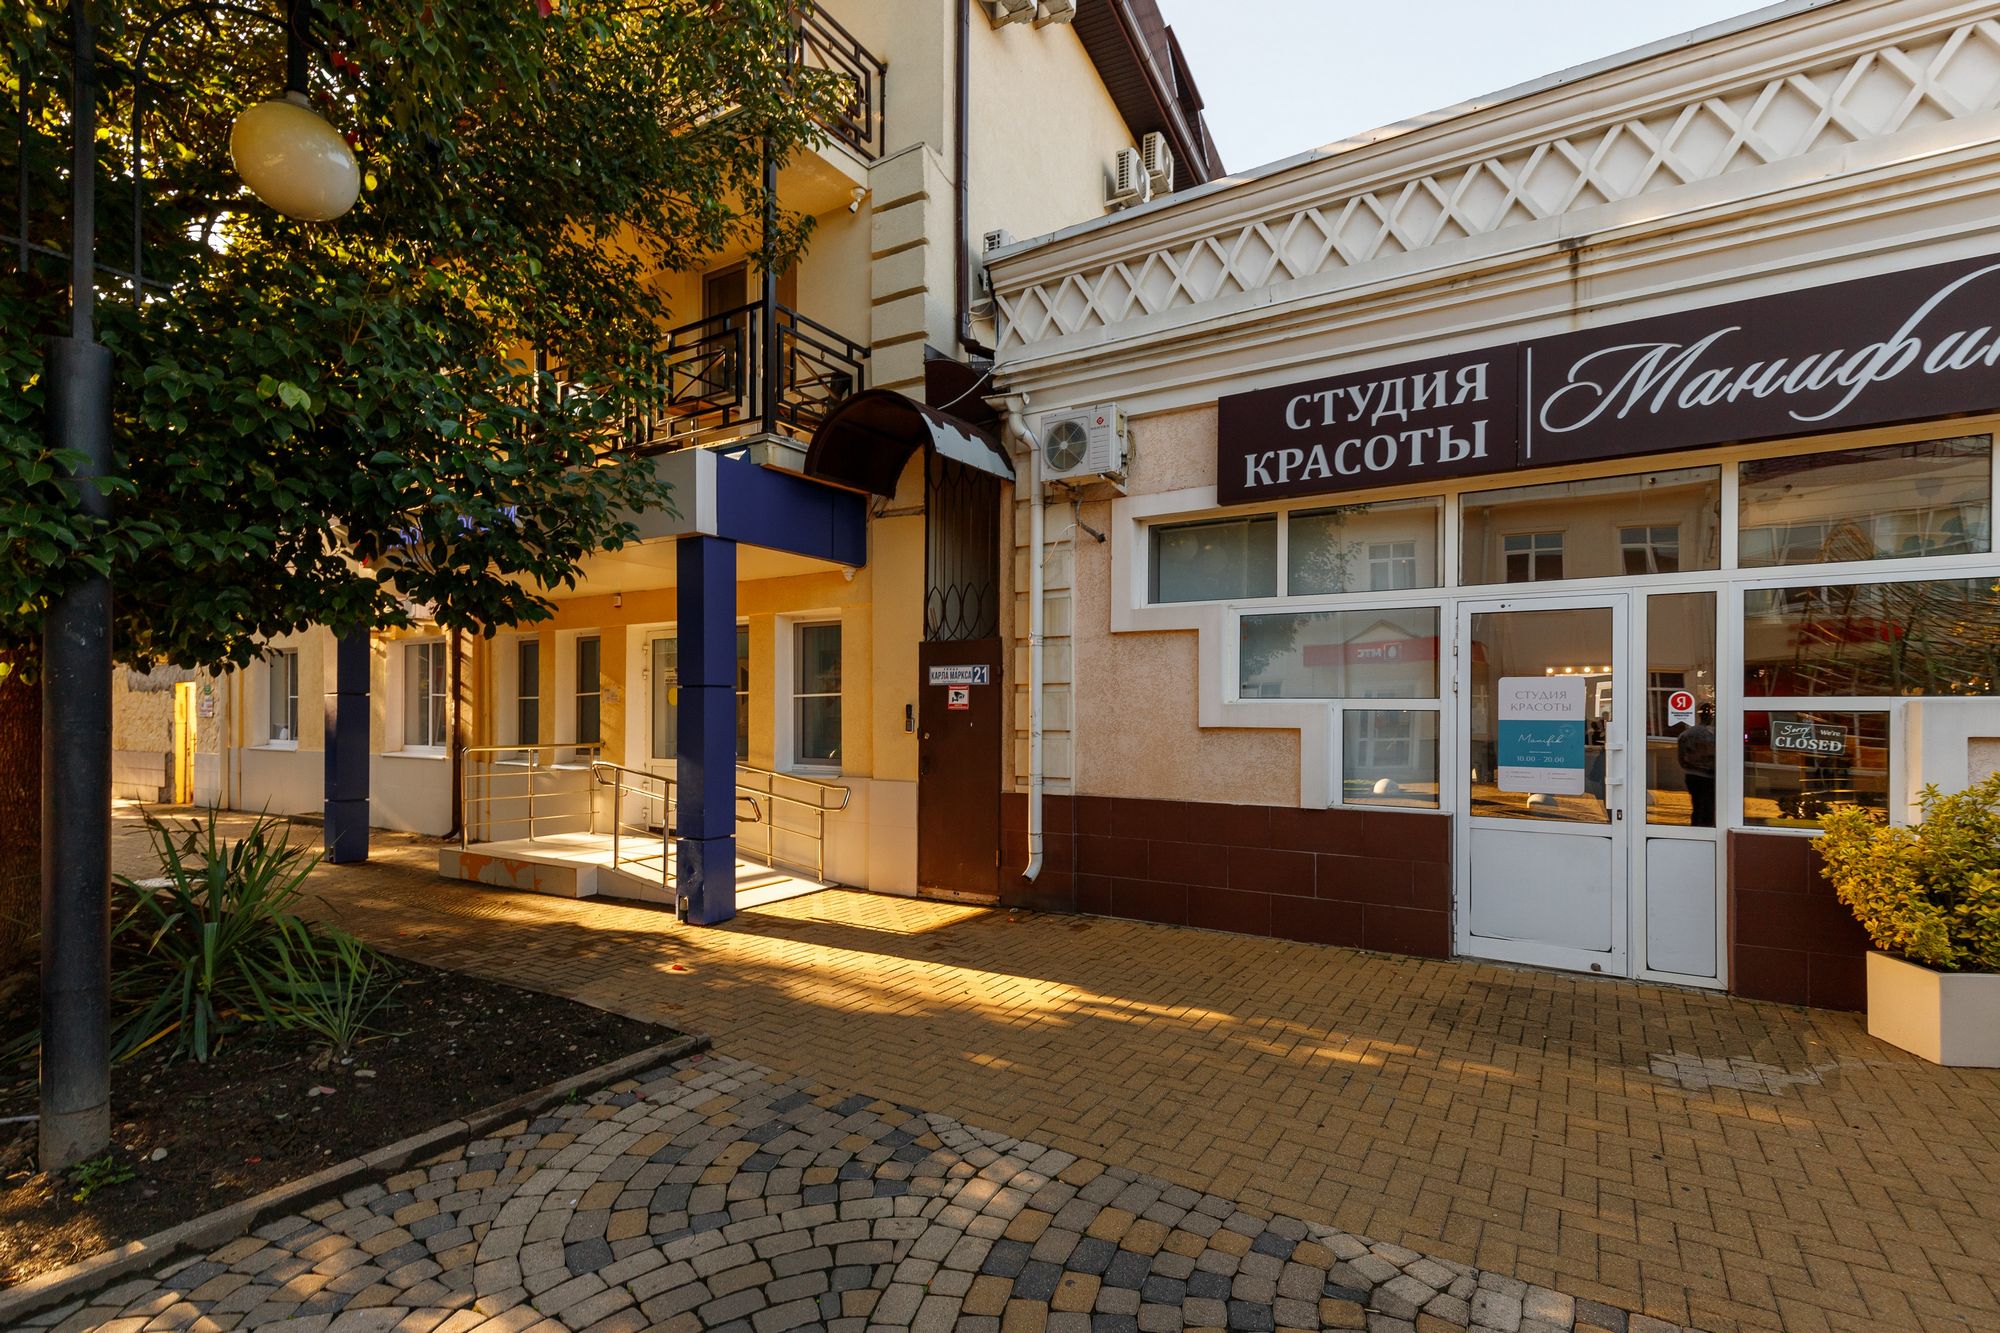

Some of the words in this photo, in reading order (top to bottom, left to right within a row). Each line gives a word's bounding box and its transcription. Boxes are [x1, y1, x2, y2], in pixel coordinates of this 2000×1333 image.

[1540, 263, 2000, 432] Манифи
[1285, 361, 1490, 431] СТУДИЯ
[1243, 419, 1489, 489] КРАСОТЫ
[931, 671, 949, 680] КАРЛА
[950, 671, 972, 680] МАРКСА
[974, 667, 987, 683] 21
[1515, 690, 1567, 700] СТУДИЯ
[1676, 696, 1686, 708] Я
[1510, 702, 1572, 712] КРАСОТЫ
[1780, 724, 1811, 739] Sorry
[1820, 729, 1841, 737] We're
[1774, 736, 1842, 752] CLOSED
